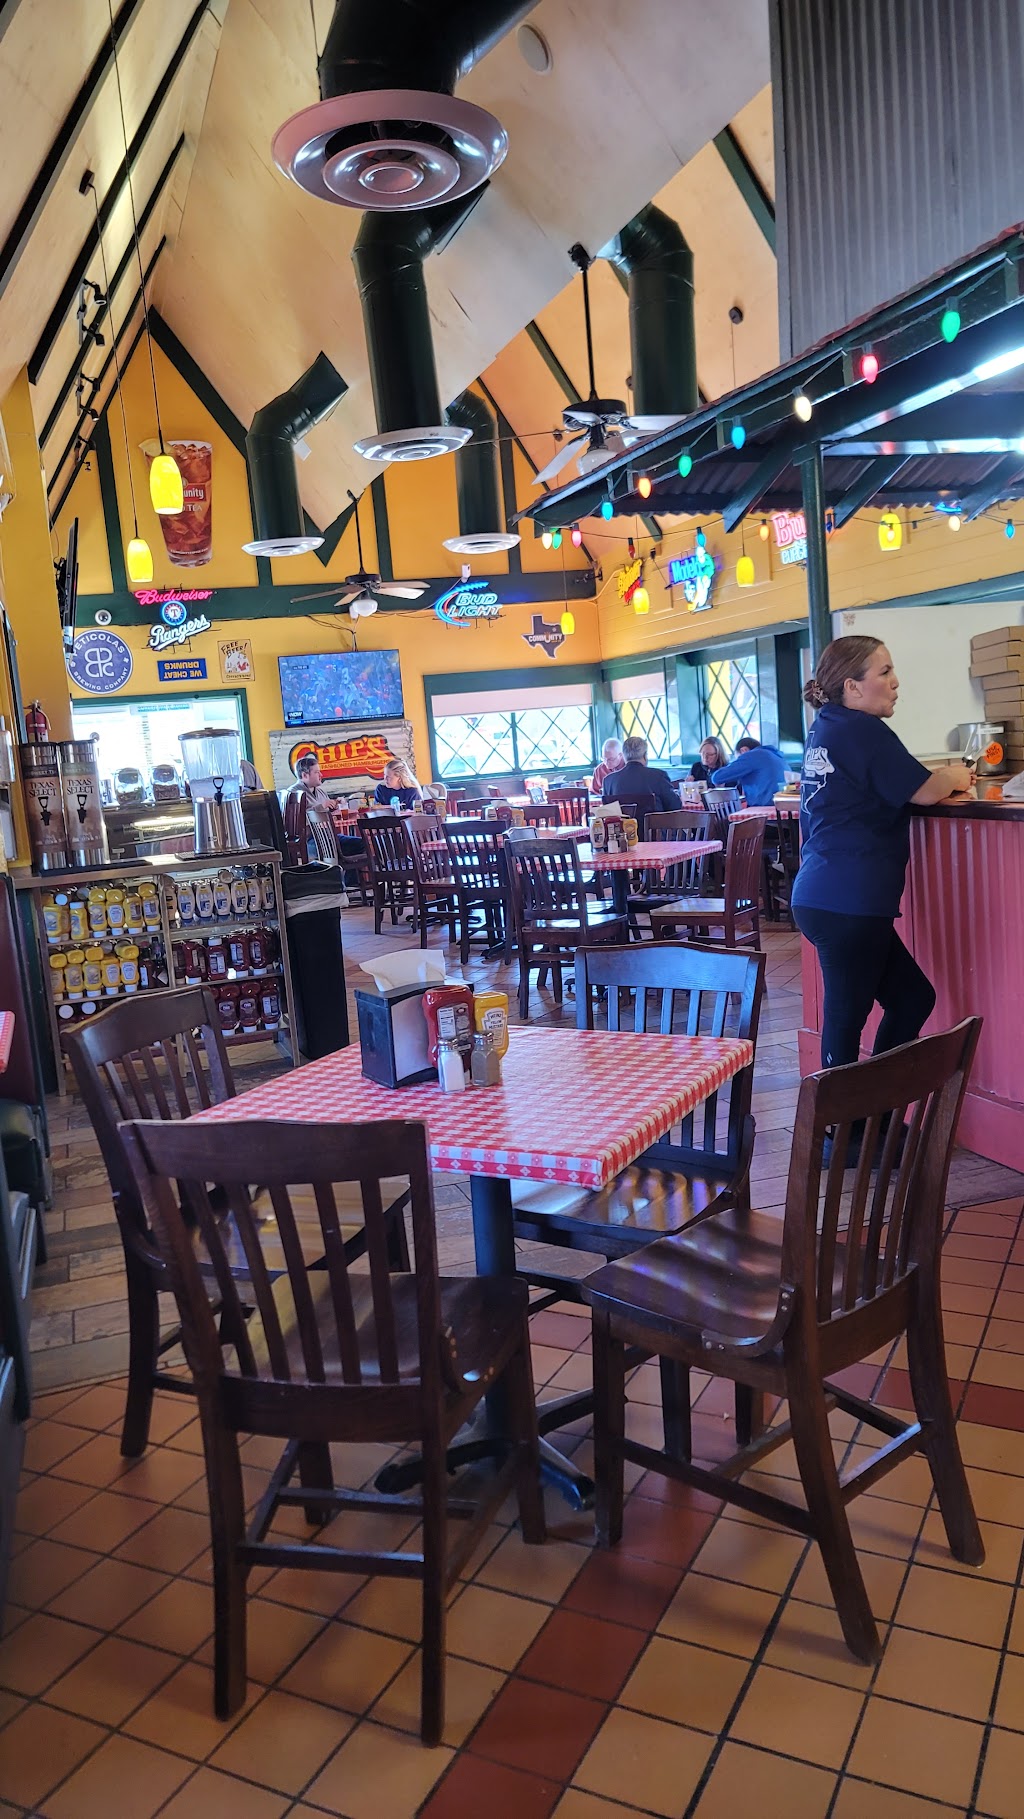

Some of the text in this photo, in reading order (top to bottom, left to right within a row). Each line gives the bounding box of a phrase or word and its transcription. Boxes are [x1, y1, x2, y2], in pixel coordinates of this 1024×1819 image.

[183, 487, 204, 500] unity
[134, 589, 213, 606] Budweiser
[455, 592, 498, 606] BUD
[447, 604, 503, 617] LIGHT
[149, 614, 211, 650] Rangers
[528, 632, 562, 643] COMMUNITY
[72, 633, 125, 657] PETICOLAS
[221, 641, 239, 655] FREE
[164, 661, 200, 670] DRUNKS
[73, 667, 128, 690] BREWING COMPANY
[164, 670, 203, 679] WE CHEAT
[290, 737, 396, 772] CHIP'S
[353, 759, 389, 767] HAMBURGER
[30, 781, 55, 790] TEXAS
[67, 778, 92, 787] TEXAS
[29, 788, 57, 798] SELECT
[67, 785, 94, 795] SELECT
